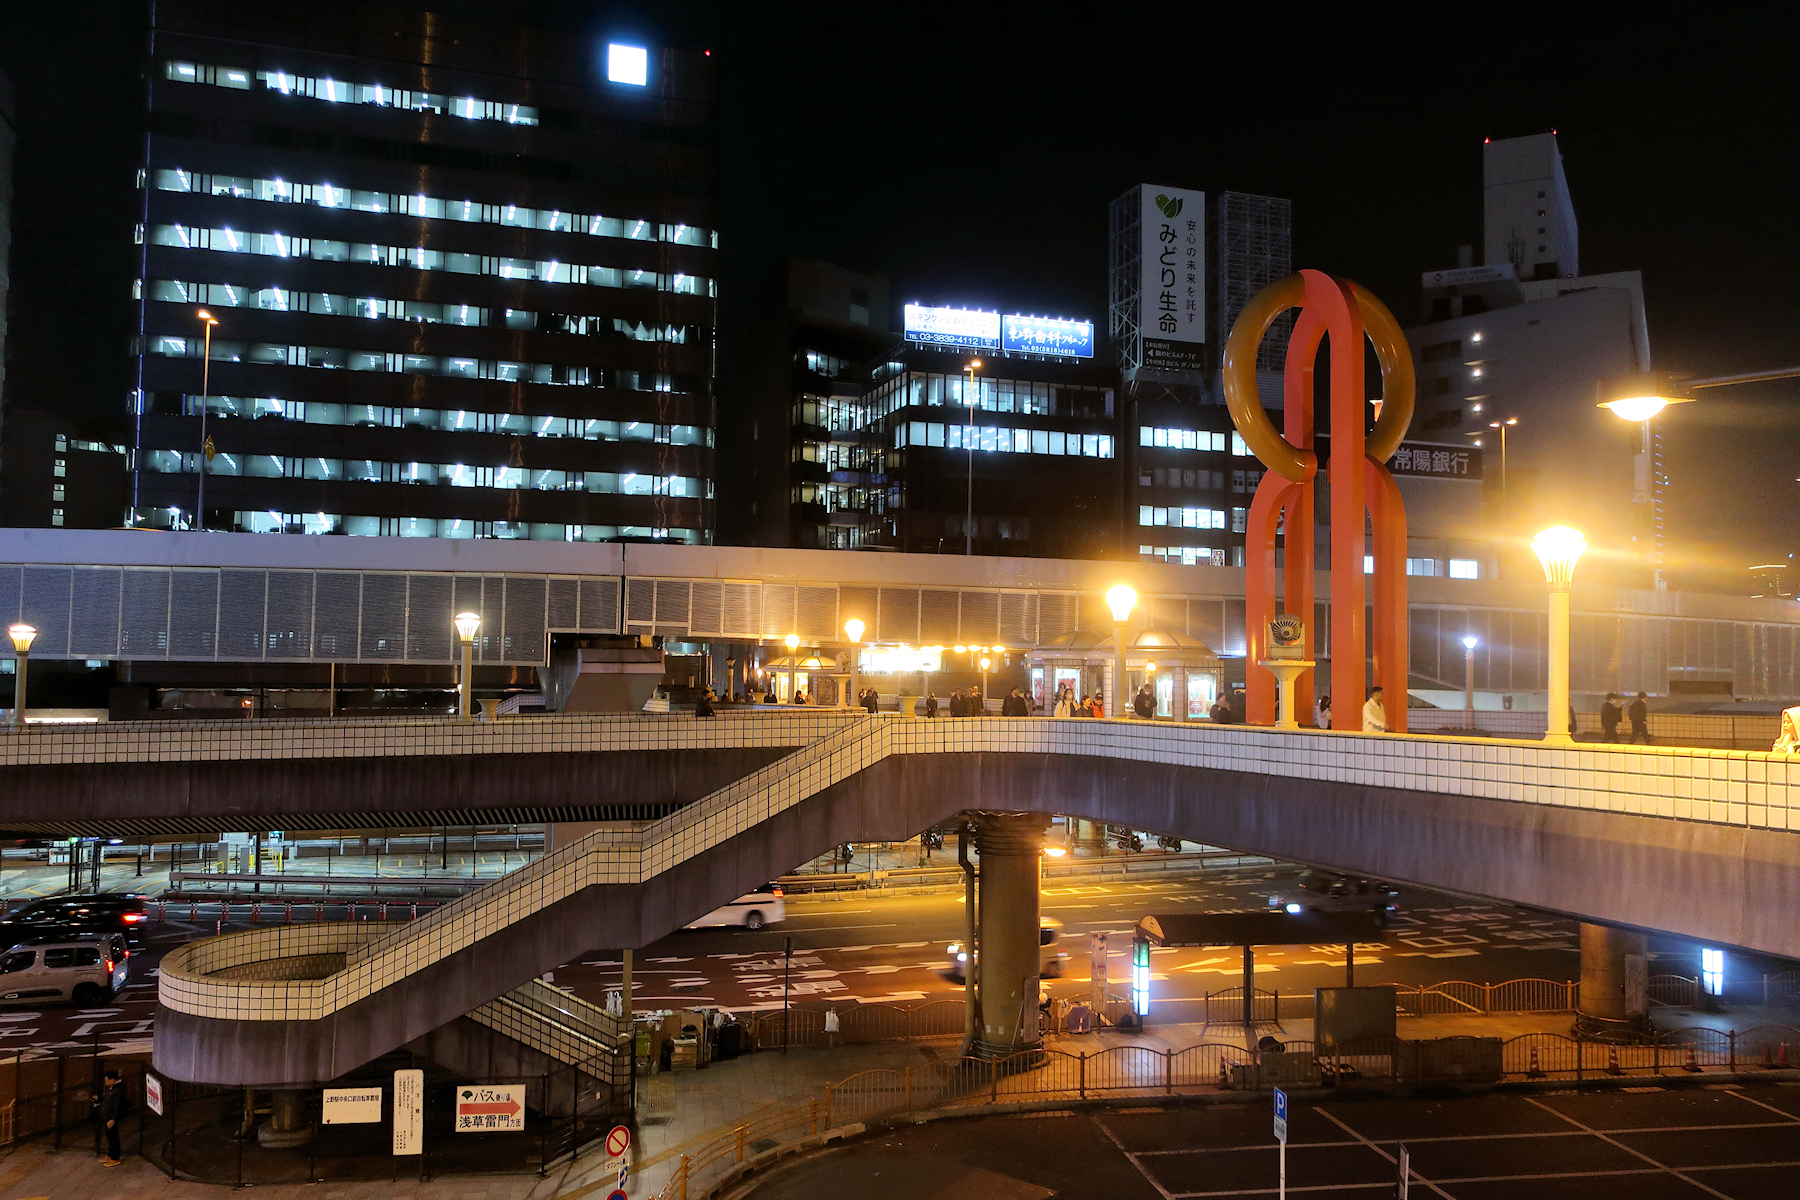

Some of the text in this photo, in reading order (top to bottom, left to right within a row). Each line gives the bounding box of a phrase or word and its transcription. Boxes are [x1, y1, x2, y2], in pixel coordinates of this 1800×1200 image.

[1158, 223, 1178, 334] みどり生命
[1186, 220, 1197, 324] 安心の未来を託す
[920, 332, 979, 346] 03-3839-4112
[1393, 447, 1470, 475] 常陽銀行
[1276, 1091, 1285, 1114] P
